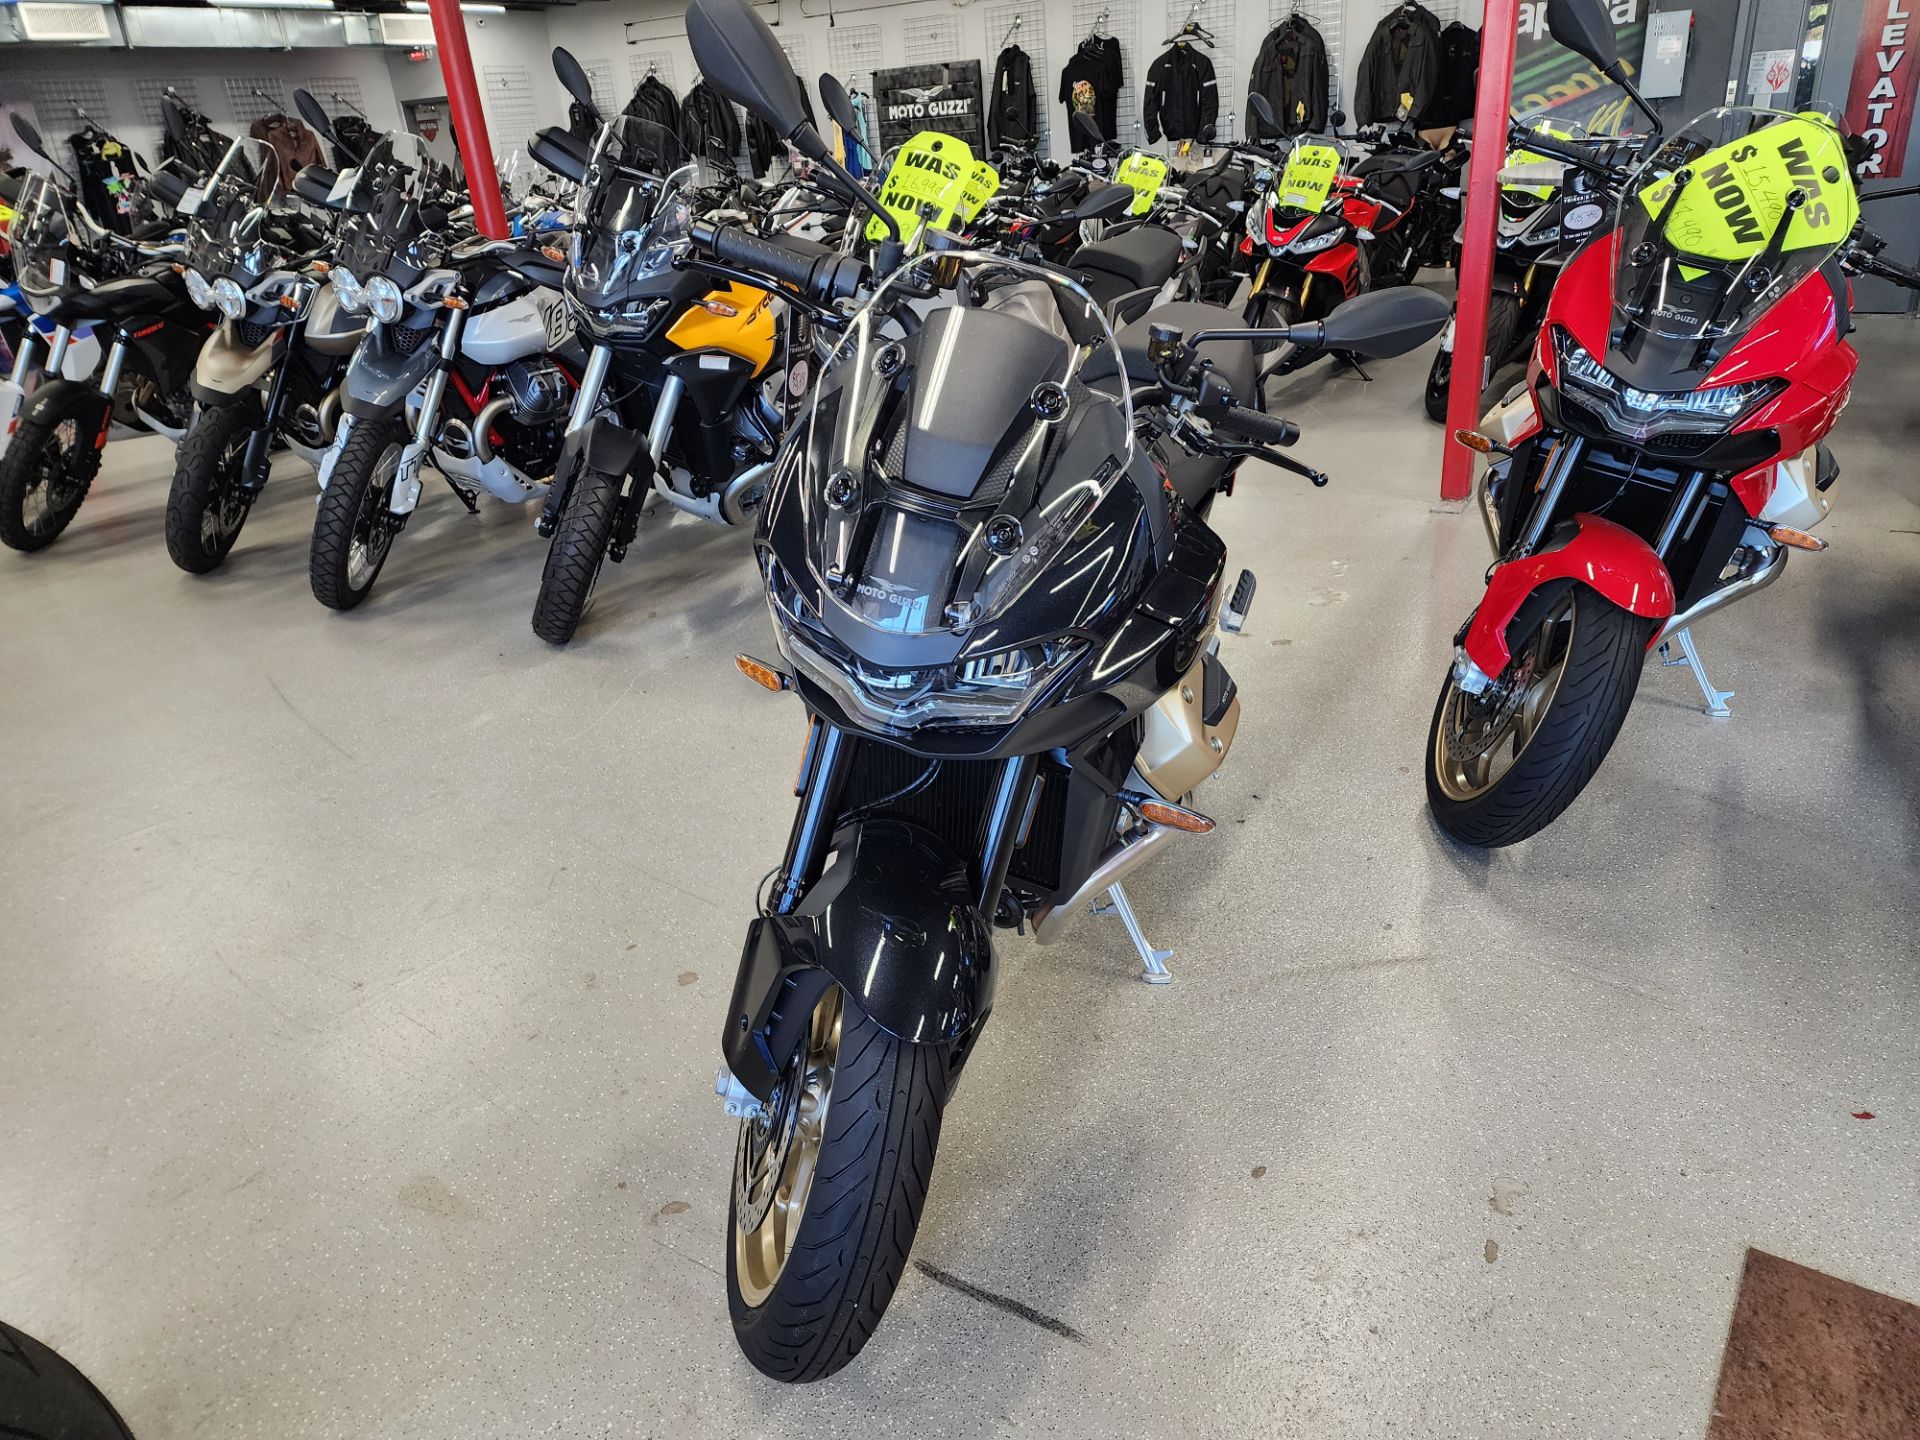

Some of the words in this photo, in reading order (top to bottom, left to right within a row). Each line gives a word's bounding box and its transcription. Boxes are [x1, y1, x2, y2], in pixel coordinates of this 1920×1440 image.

[889, 104, 924, 120] MOTO
[928, 99, 969, 117] GUZZI
[1296, 157, 1332, 168] WAS
[1730, 144, 1758, 163] $
[904, 152, 961, 180] WAS
[888, 174, 899, 189] $
[1287, 179, 1324, 192] NOW
[1777, 137, 1830, 229] WAS
[883, 192, 943, 223] NOW
[1700, 162, 1765, 244] NOW
[1651, 308, 1673, 320] MOTO
[1675, 313, 1698, 325] GUZZI
[856, 583, 887, 600] MOTO
[889, 593, 924, 611] GUZZI
